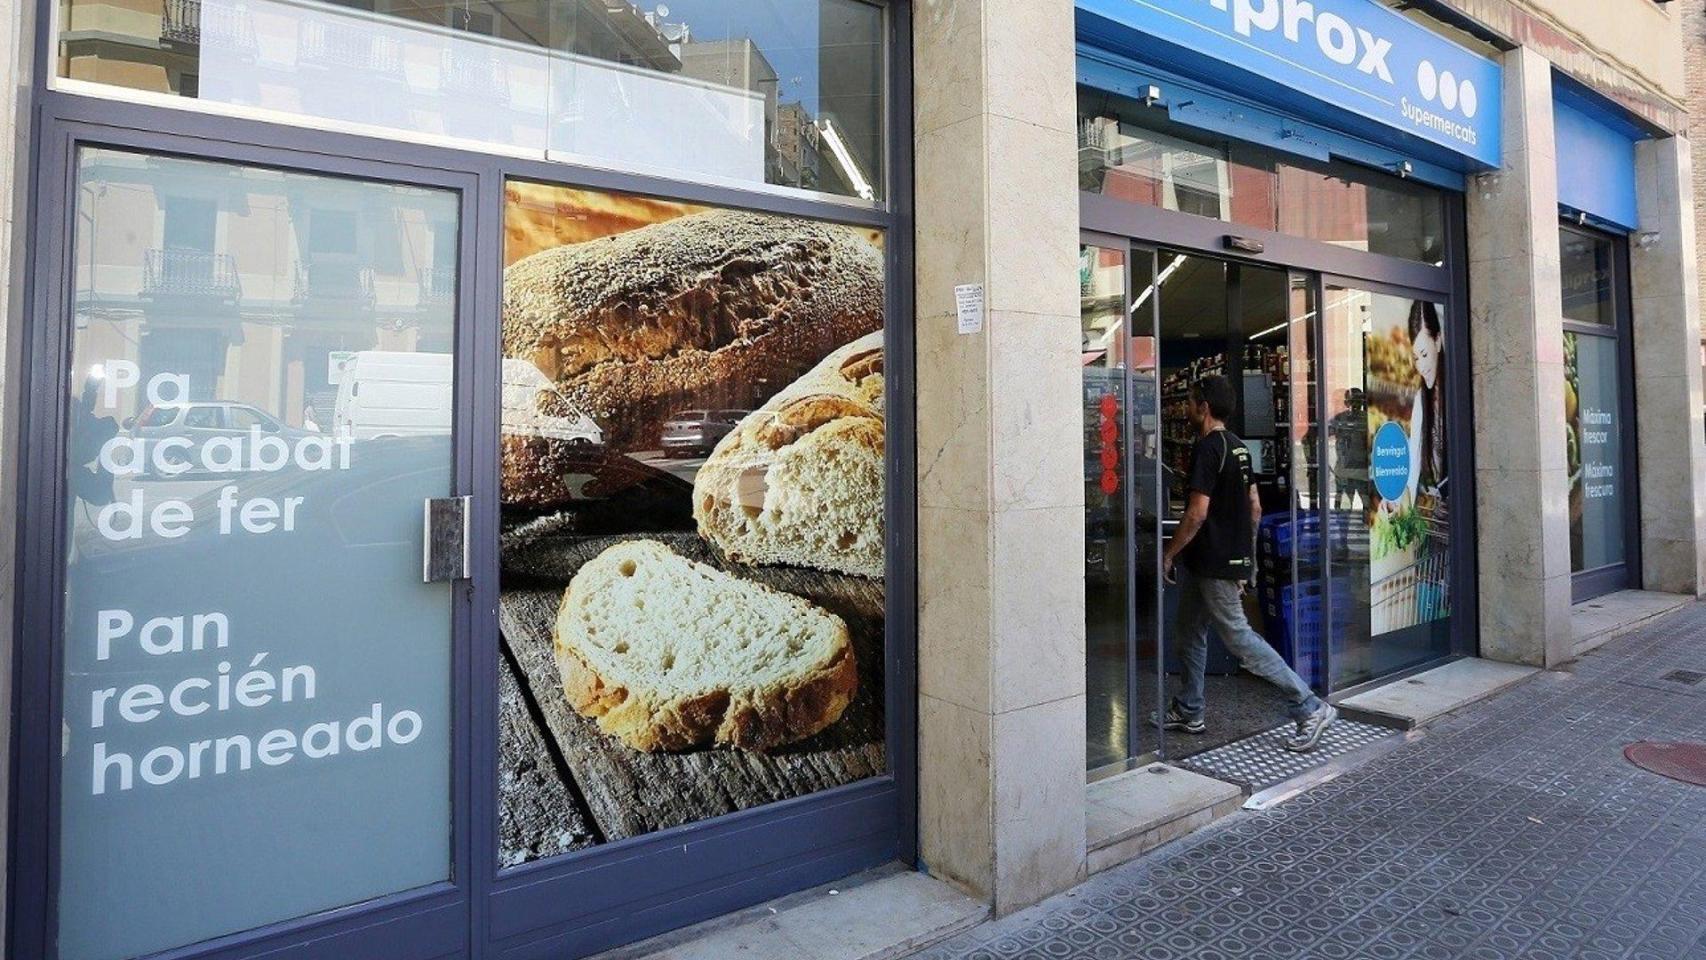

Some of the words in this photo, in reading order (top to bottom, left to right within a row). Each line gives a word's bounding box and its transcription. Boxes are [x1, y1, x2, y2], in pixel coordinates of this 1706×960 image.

[1210, 0, 1394, 85] prox
[1401, 96, 1477, 145] Supermercats
[103, 359, 191, 408] Pa
[99, 424, 356, 475] acabat
[1583, 428, 1608, 444] frescor
[1375, 465, 1408, 477] Bienvenido
[1585, 483, 1614, 498] frescura
[97, 488, 194, 541] de
[217, 486, 304, 535] fer
[96, 609, 229, 661] Pan
[91, 652, 316, 728] recién
[92, 703, 423, 795] horneado
